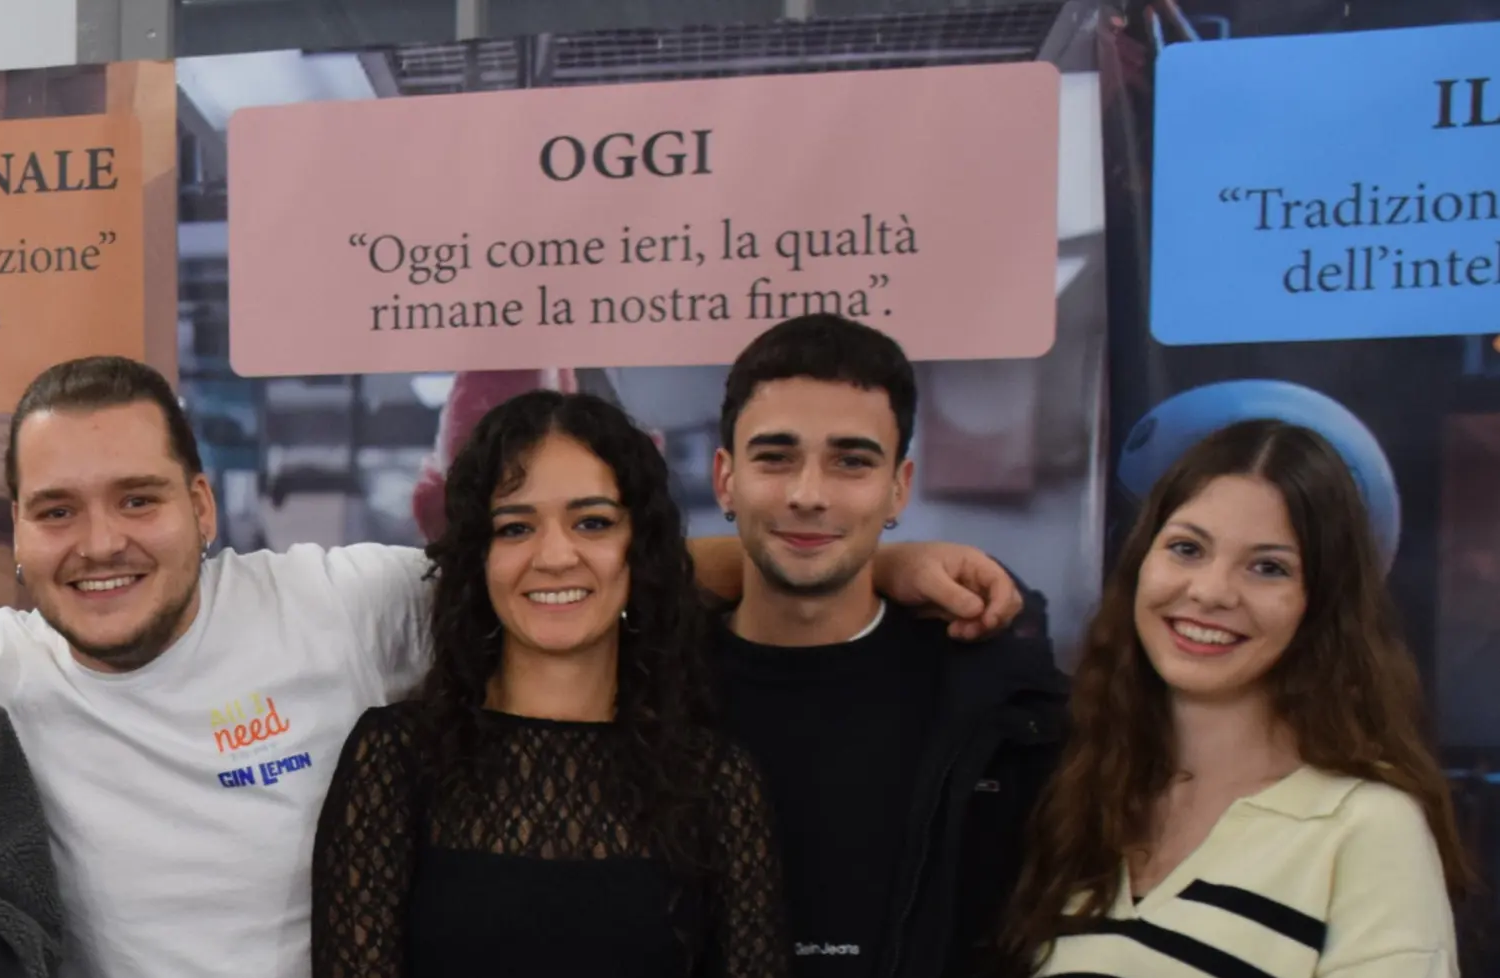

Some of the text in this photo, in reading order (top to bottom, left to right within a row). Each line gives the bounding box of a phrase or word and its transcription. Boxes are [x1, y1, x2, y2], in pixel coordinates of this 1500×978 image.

[539, 129, 714, 182] OGGI
[348, 213, 920, 286] “Oggi come ieri, la qualtà
[369, 294, 525, 333] rimane
[537, 284, 574, 327] la
[588, 285, 733, 325] nostra
[214, 696, 290, 753] need
[217, 766, 256, 788] GIN
